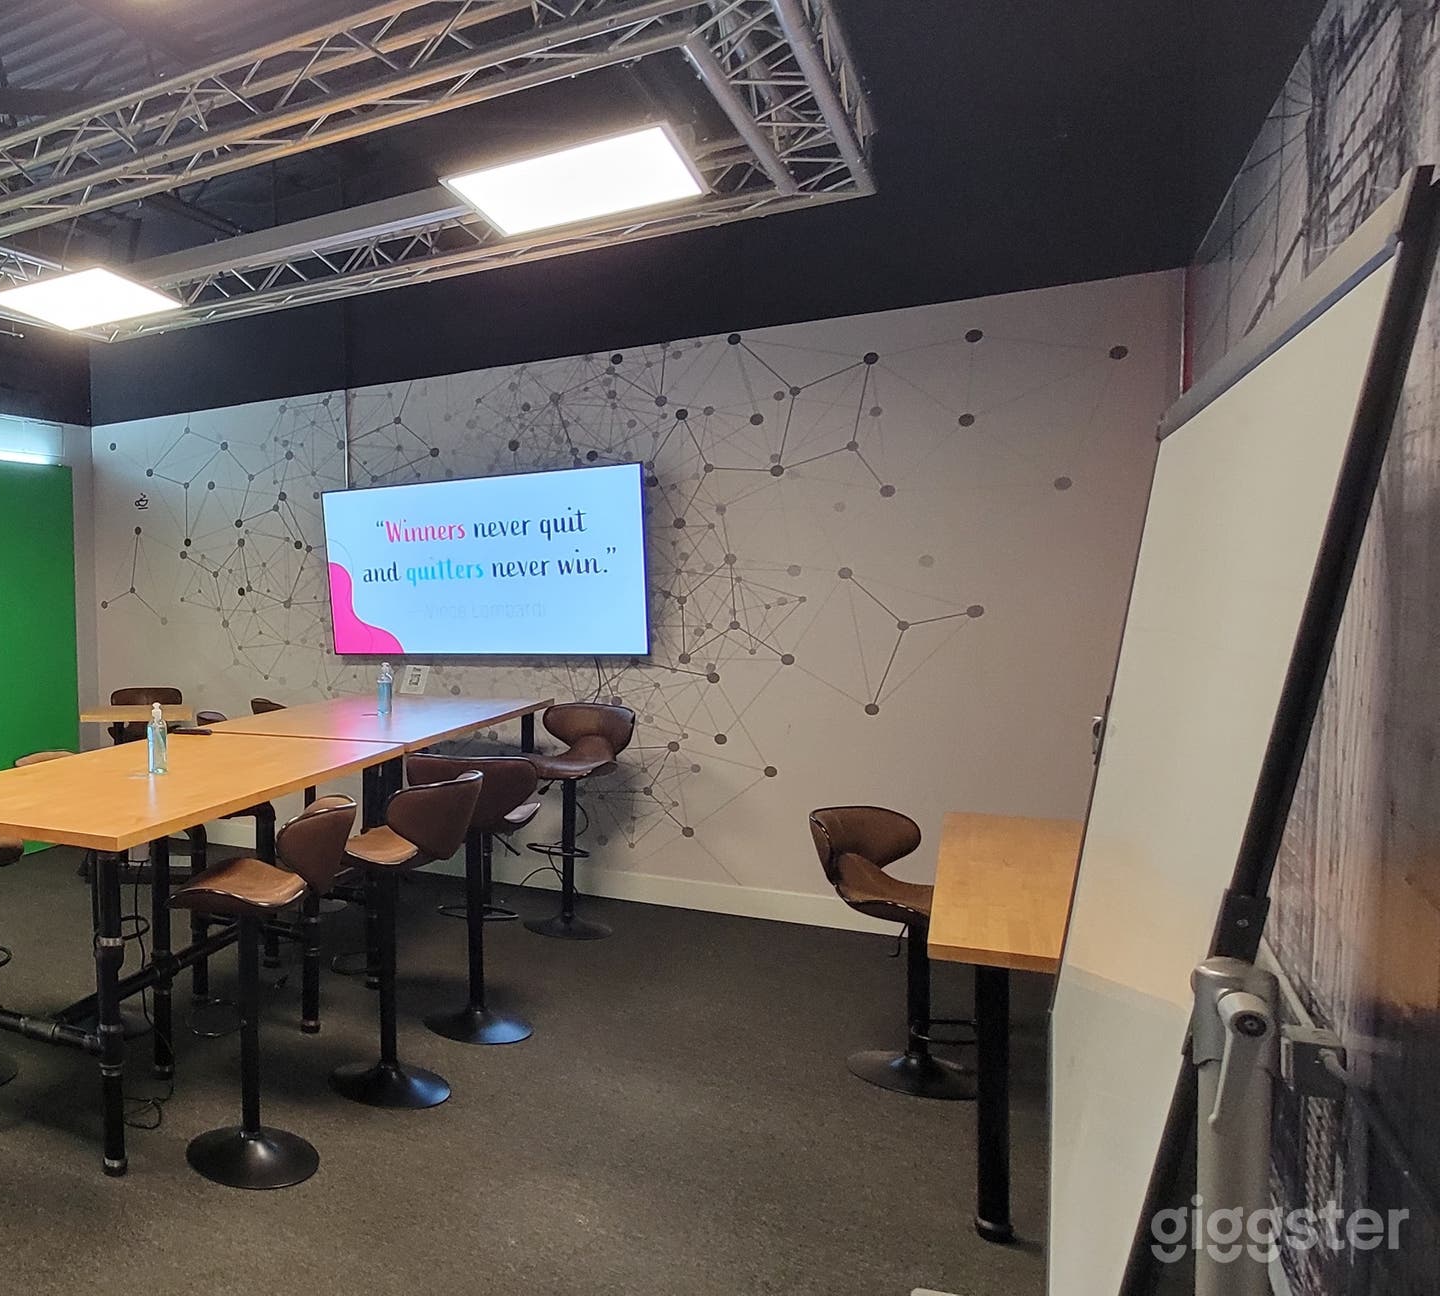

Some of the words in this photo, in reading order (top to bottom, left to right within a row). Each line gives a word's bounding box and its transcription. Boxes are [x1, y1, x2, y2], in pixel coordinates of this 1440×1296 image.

[376, 519, 466, 543] “Winners
[473, 519, 532, 538] never
[539, 506, 587, 541] quit
[362, 561, 401, 583] and
[406, 556, 484, 587] quitters
[492, 560, 550, 578] never
